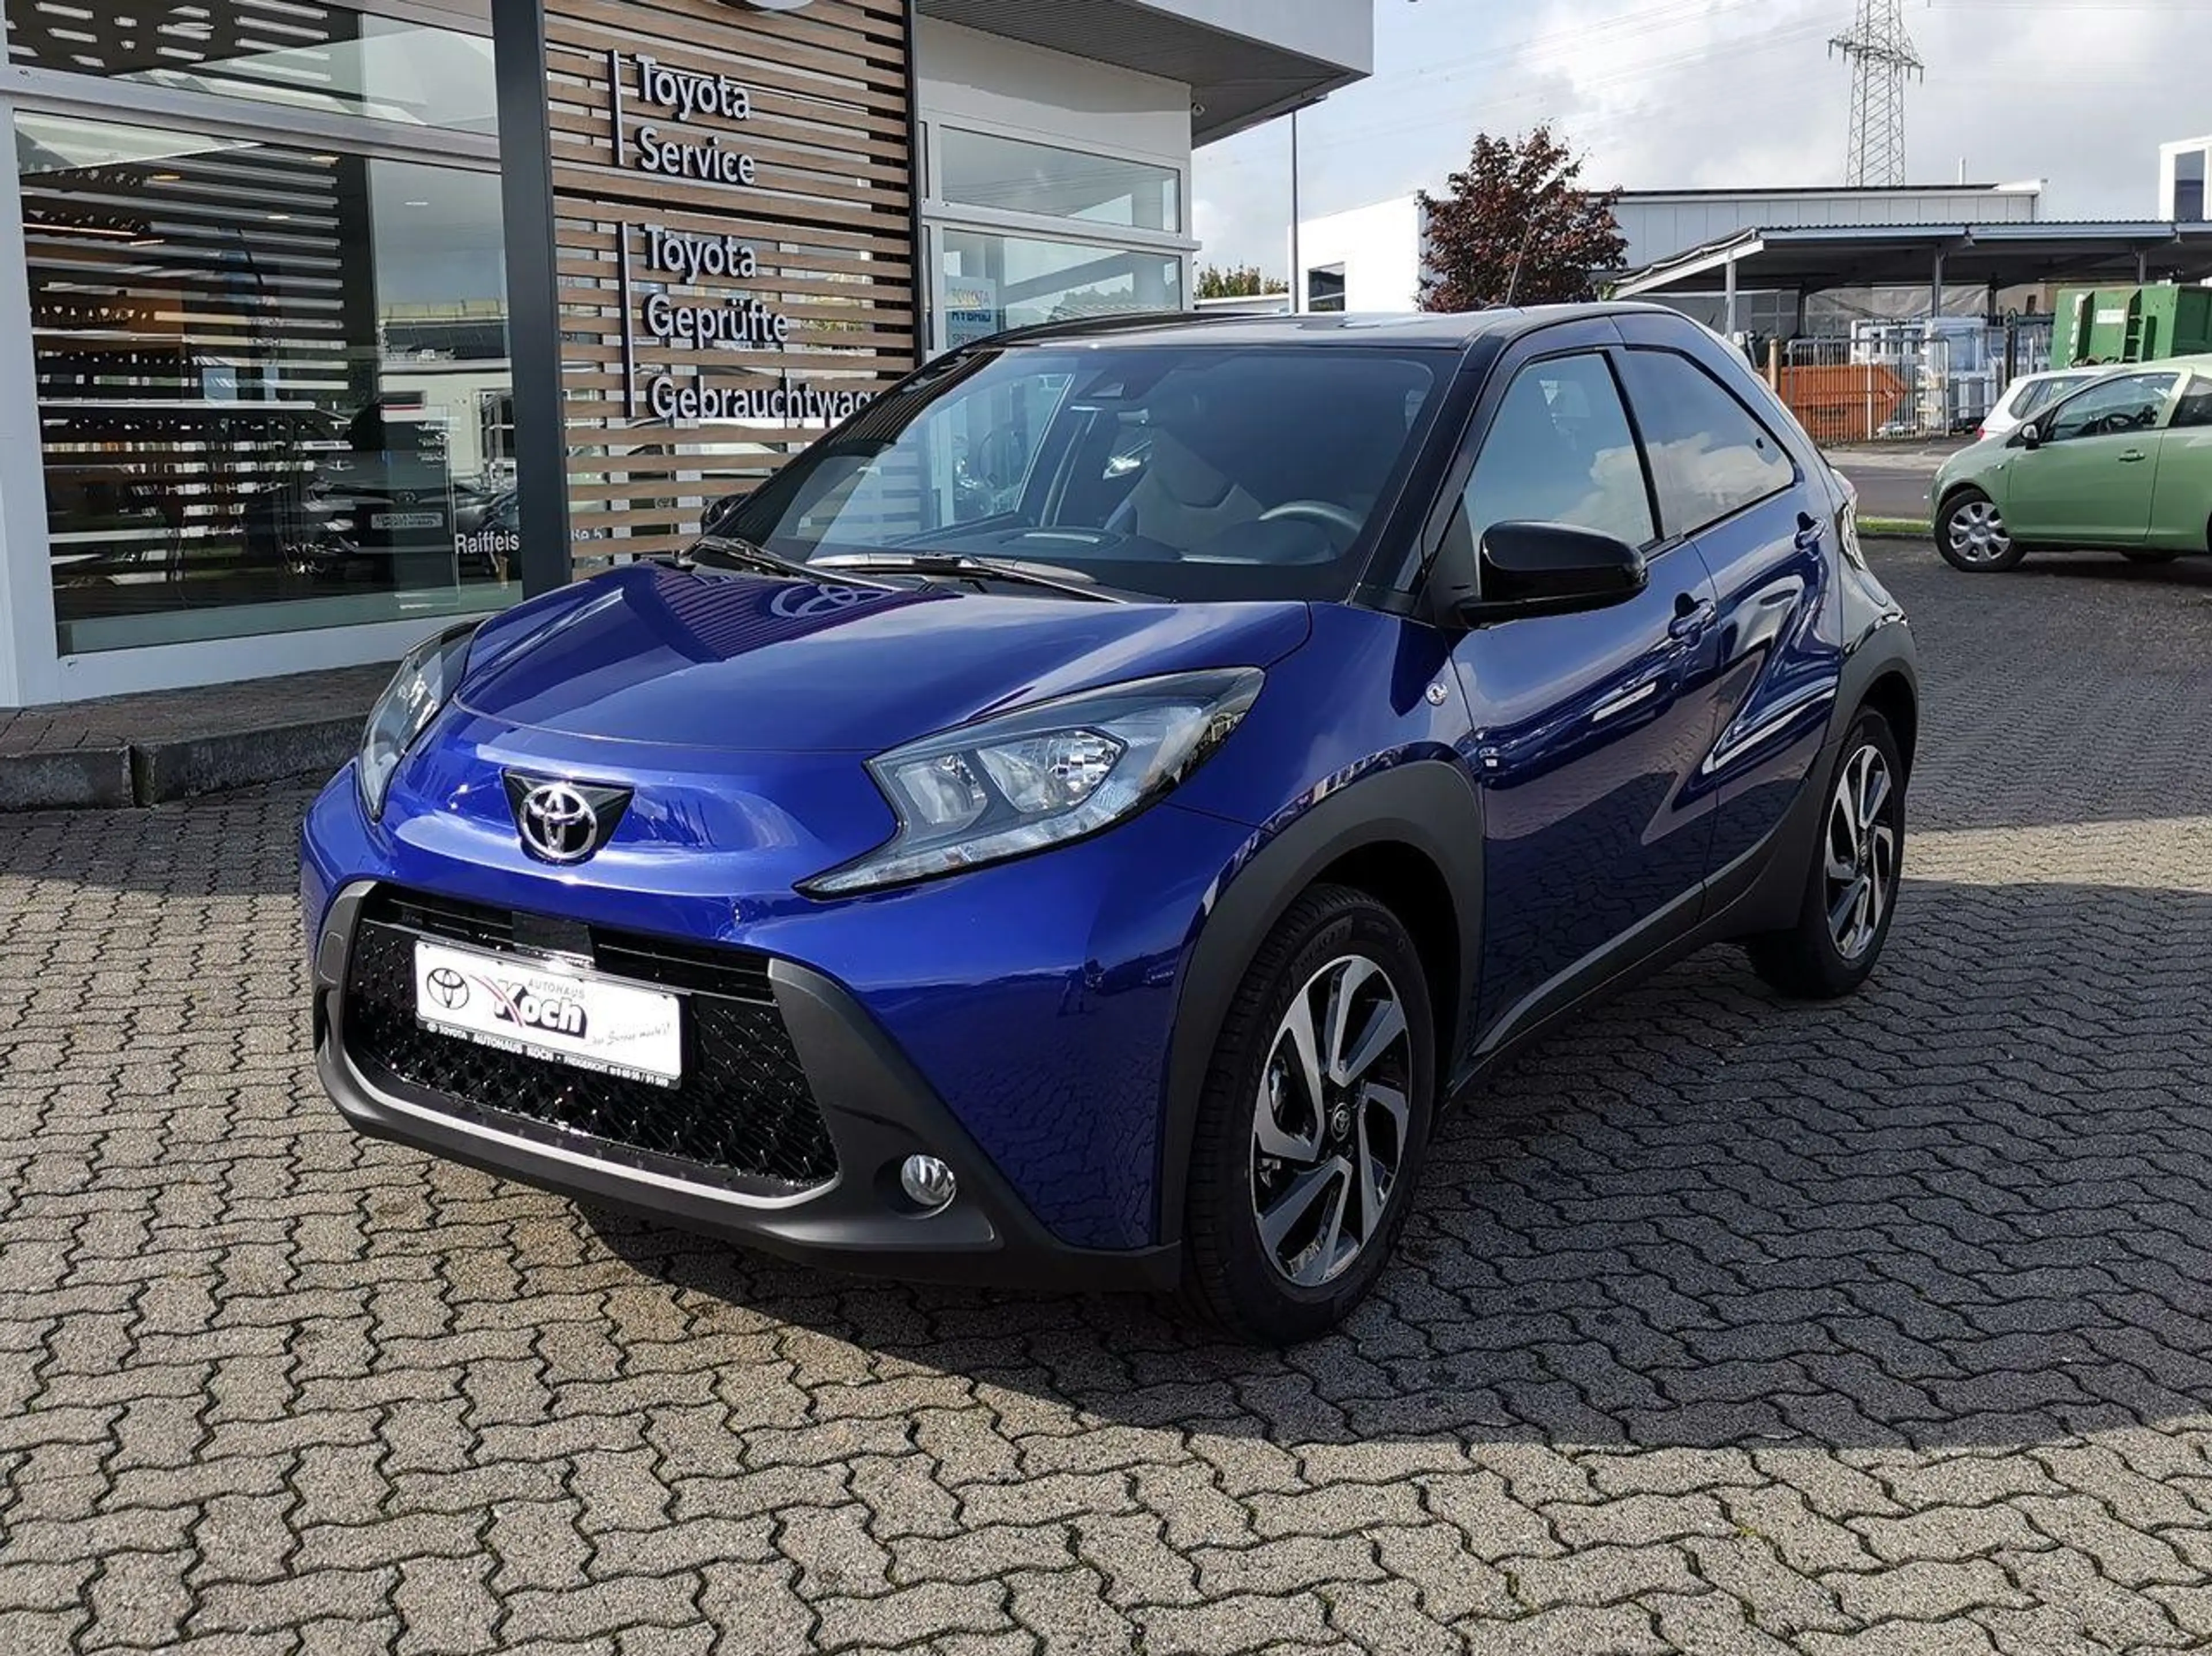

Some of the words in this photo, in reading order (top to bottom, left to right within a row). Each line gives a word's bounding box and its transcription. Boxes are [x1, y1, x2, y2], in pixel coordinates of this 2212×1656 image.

[635, 54, 751, 121] Toyota
[640, 125, 755, 184] Service
[644, 223, 756, 284] Toyota
[647, 293, 789, 349] Geprüfte
[494, 979, 588, 1039] Koch
[528, 978, 585, 1000] AUTOHAUS
[438, 1024, 468, 1040] TOYOTA
[472, 1032, 523, 1054] AUTOHAUS
[527, 1045, 554, 1063] KOCH
